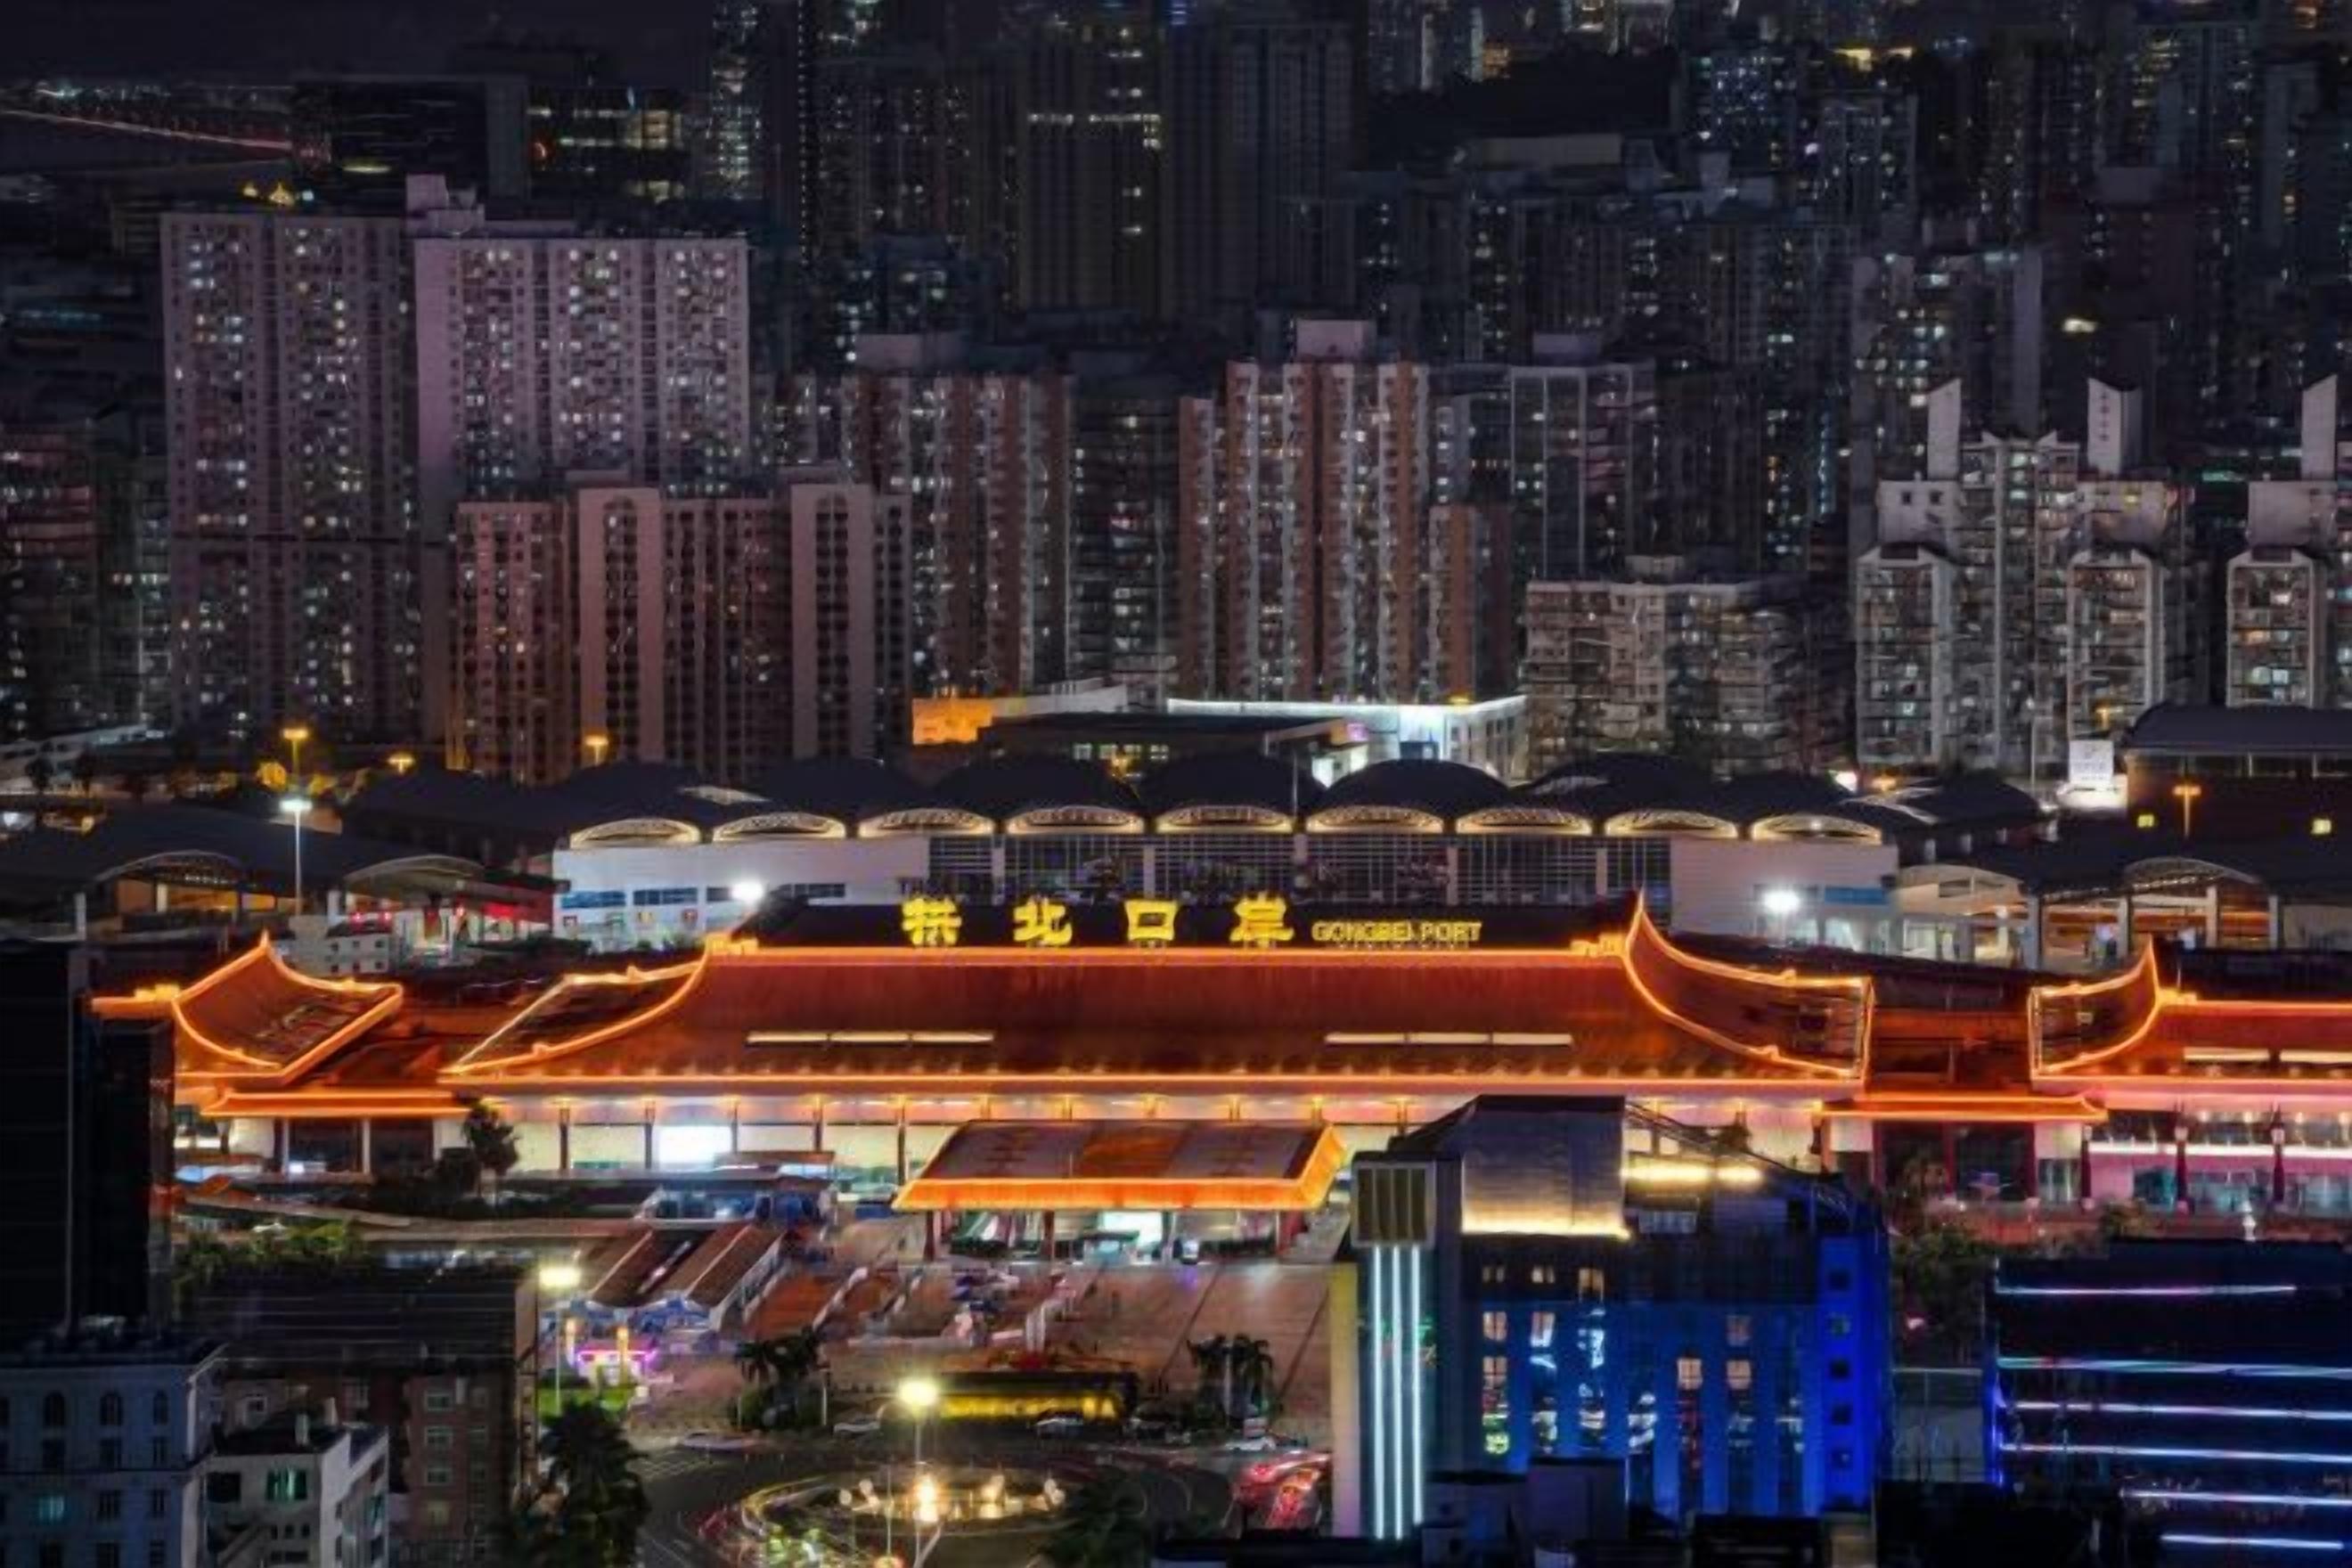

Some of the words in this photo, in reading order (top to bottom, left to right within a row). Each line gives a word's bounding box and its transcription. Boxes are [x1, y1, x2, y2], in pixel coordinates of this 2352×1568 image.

[902, 894, 1294, 945] 拱北口岸
[1311, 920, 1412, 942] GONGBEI
[1419, 920, 1482, 942] PORT
